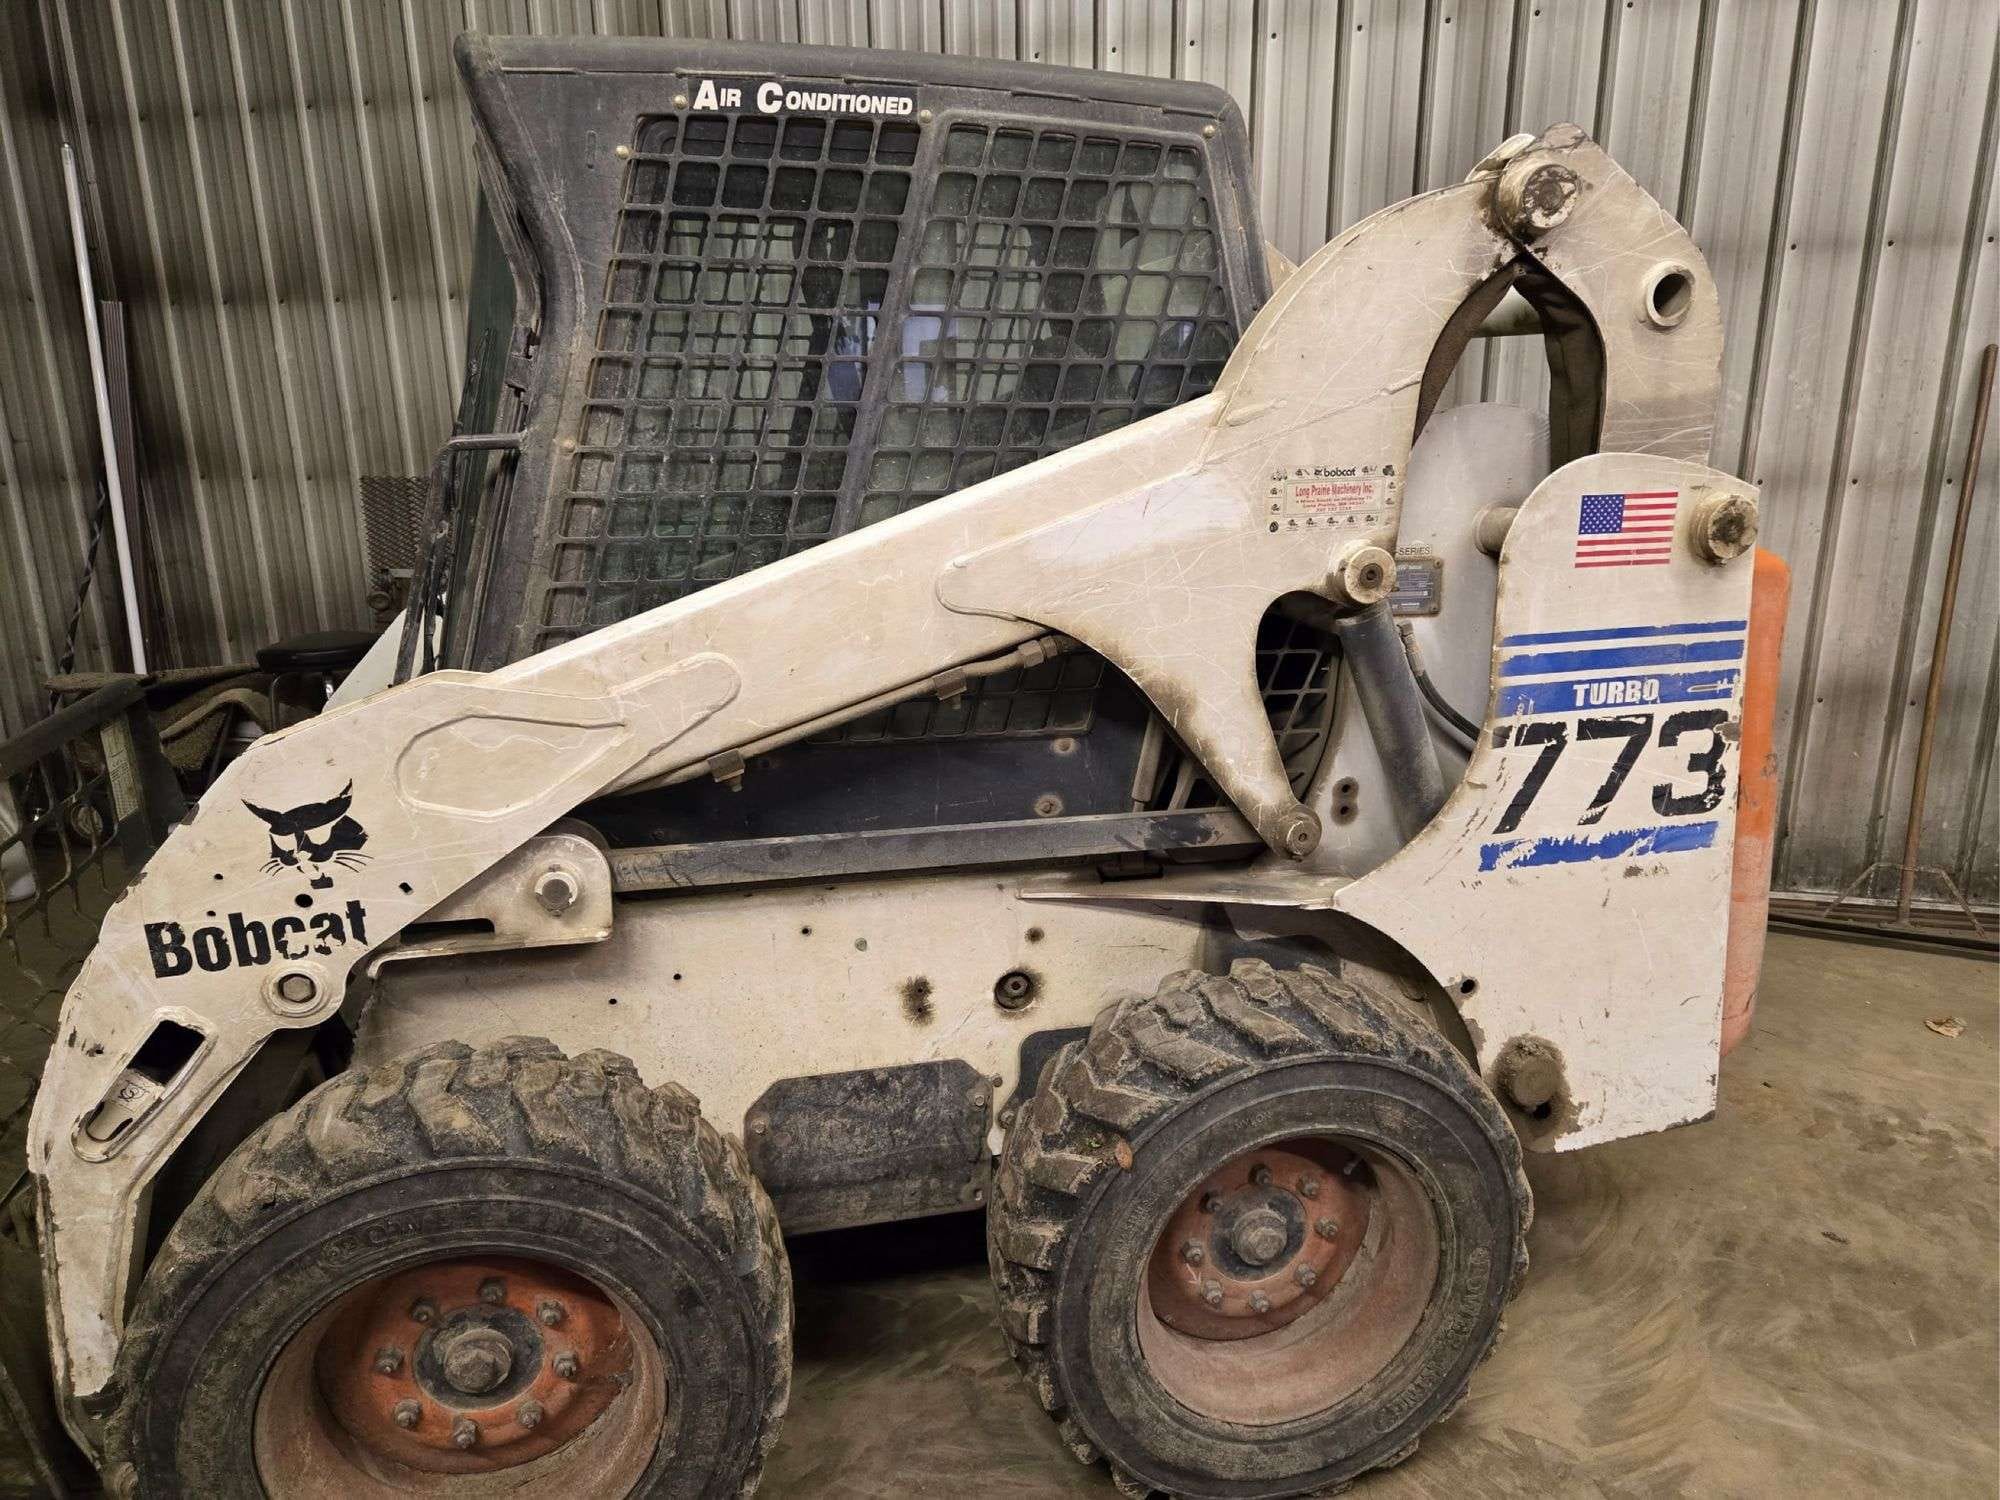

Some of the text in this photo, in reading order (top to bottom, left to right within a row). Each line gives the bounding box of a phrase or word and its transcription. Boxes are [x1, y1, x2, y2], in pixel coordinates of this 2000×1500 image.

[1323, 467, 1356, 477] bobcat
[1295, 484, 1310, 498] Long
[1311, 484, 1331, 497] Prairie
[1332, 482, 1361, 495] Machinery
[1399, 546, 1431, 556] SERIES
[1573, 679, 1659, 707] TURBO
[1492, 709, 1729, 835] 773
[144, 900, 369, 979] Bobcat
